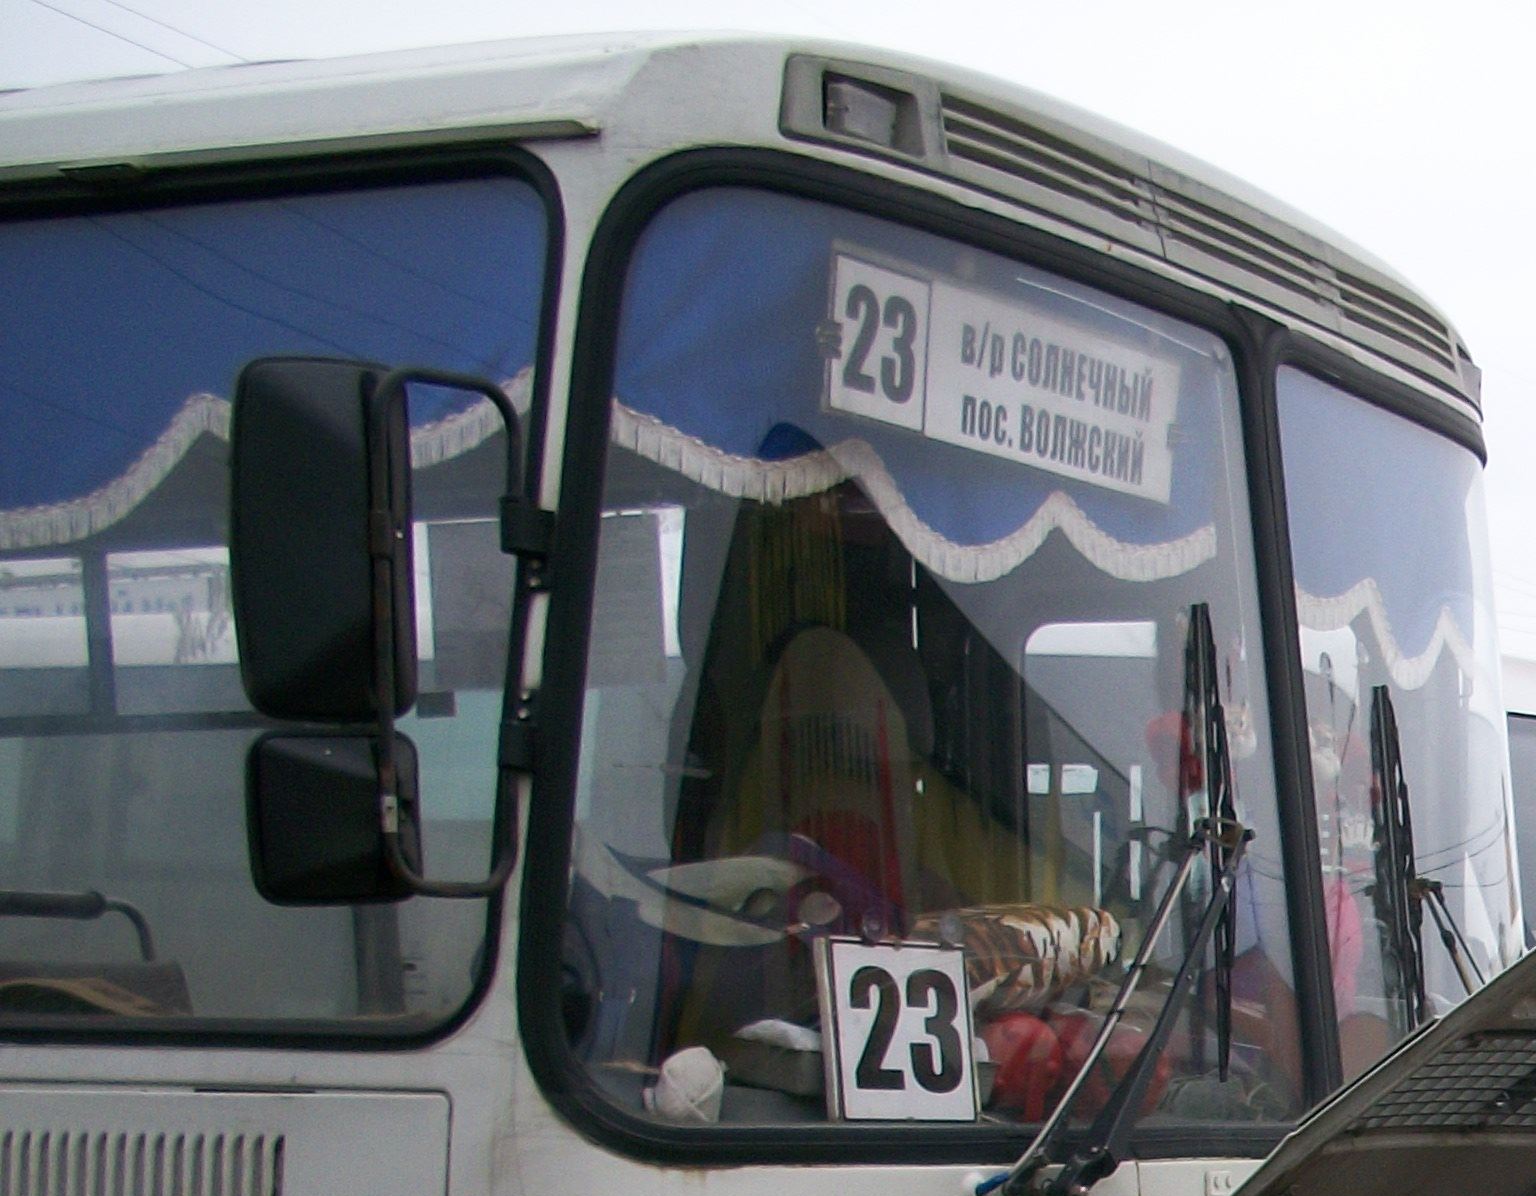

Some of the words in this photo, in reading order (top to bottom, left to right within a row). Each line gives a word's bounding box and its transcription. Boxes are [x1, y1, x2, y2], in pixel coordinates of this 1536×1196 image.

[842, 284, 918, 404] 23
[1010, 331, 1155, 423] СОЛНЕЧНЫЙ
[1019, 403, 1146, 486] ВОЛЖСКИЙ
[850, 965, 963, 1094] 23
